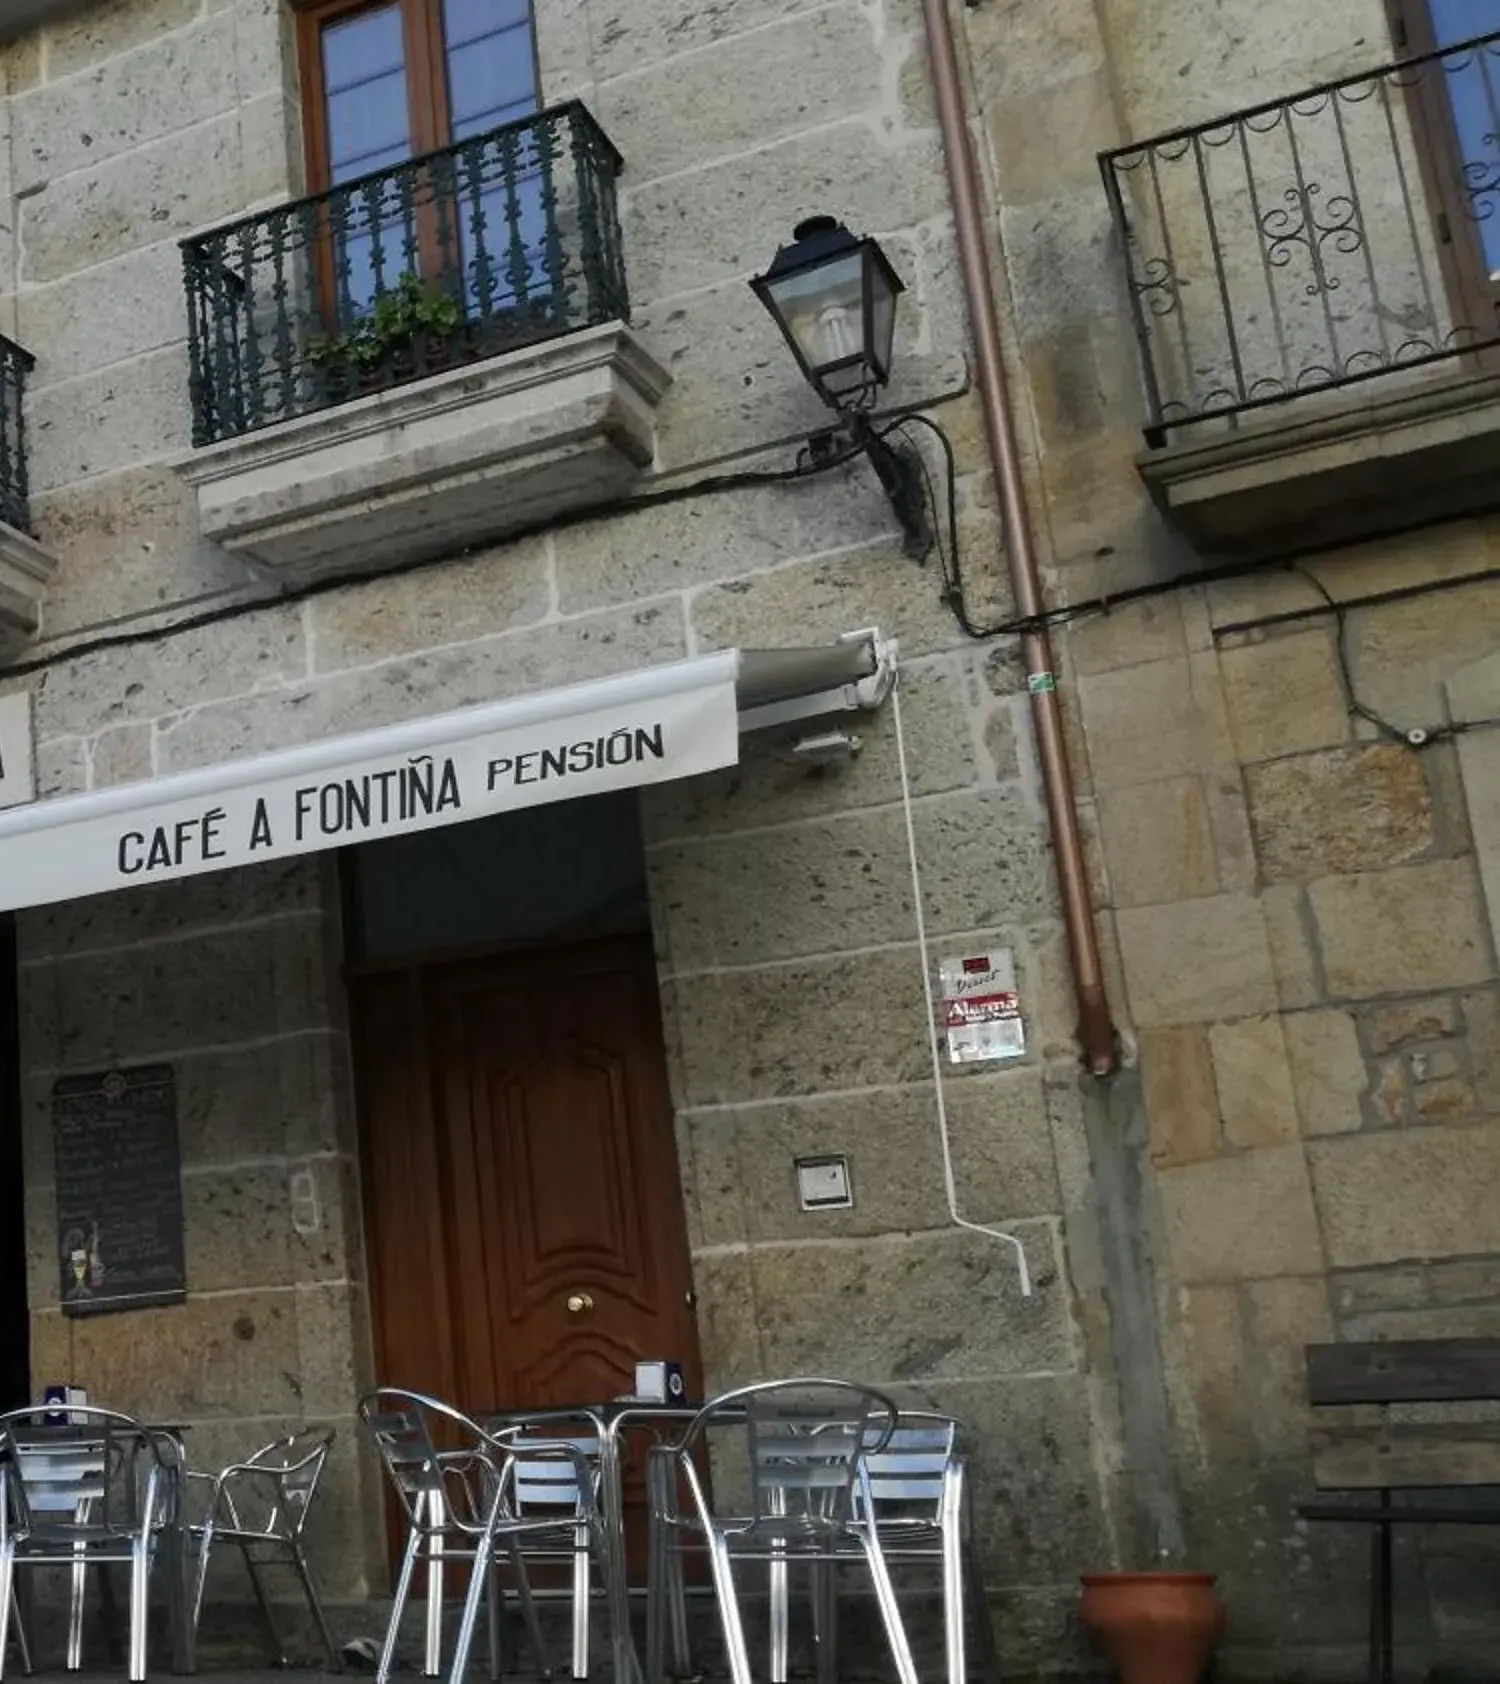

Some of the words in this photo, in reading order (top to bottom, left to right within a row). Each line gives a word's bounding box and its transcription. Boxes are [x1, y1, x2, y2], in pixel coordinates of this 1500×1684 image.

[118, 807, 226, 874] CAFÉ
[249, 798, 273, 850] A
[295, 755, 461, 841] FONTIÑA
[487, 724, 664, 791] PENSIÓN
